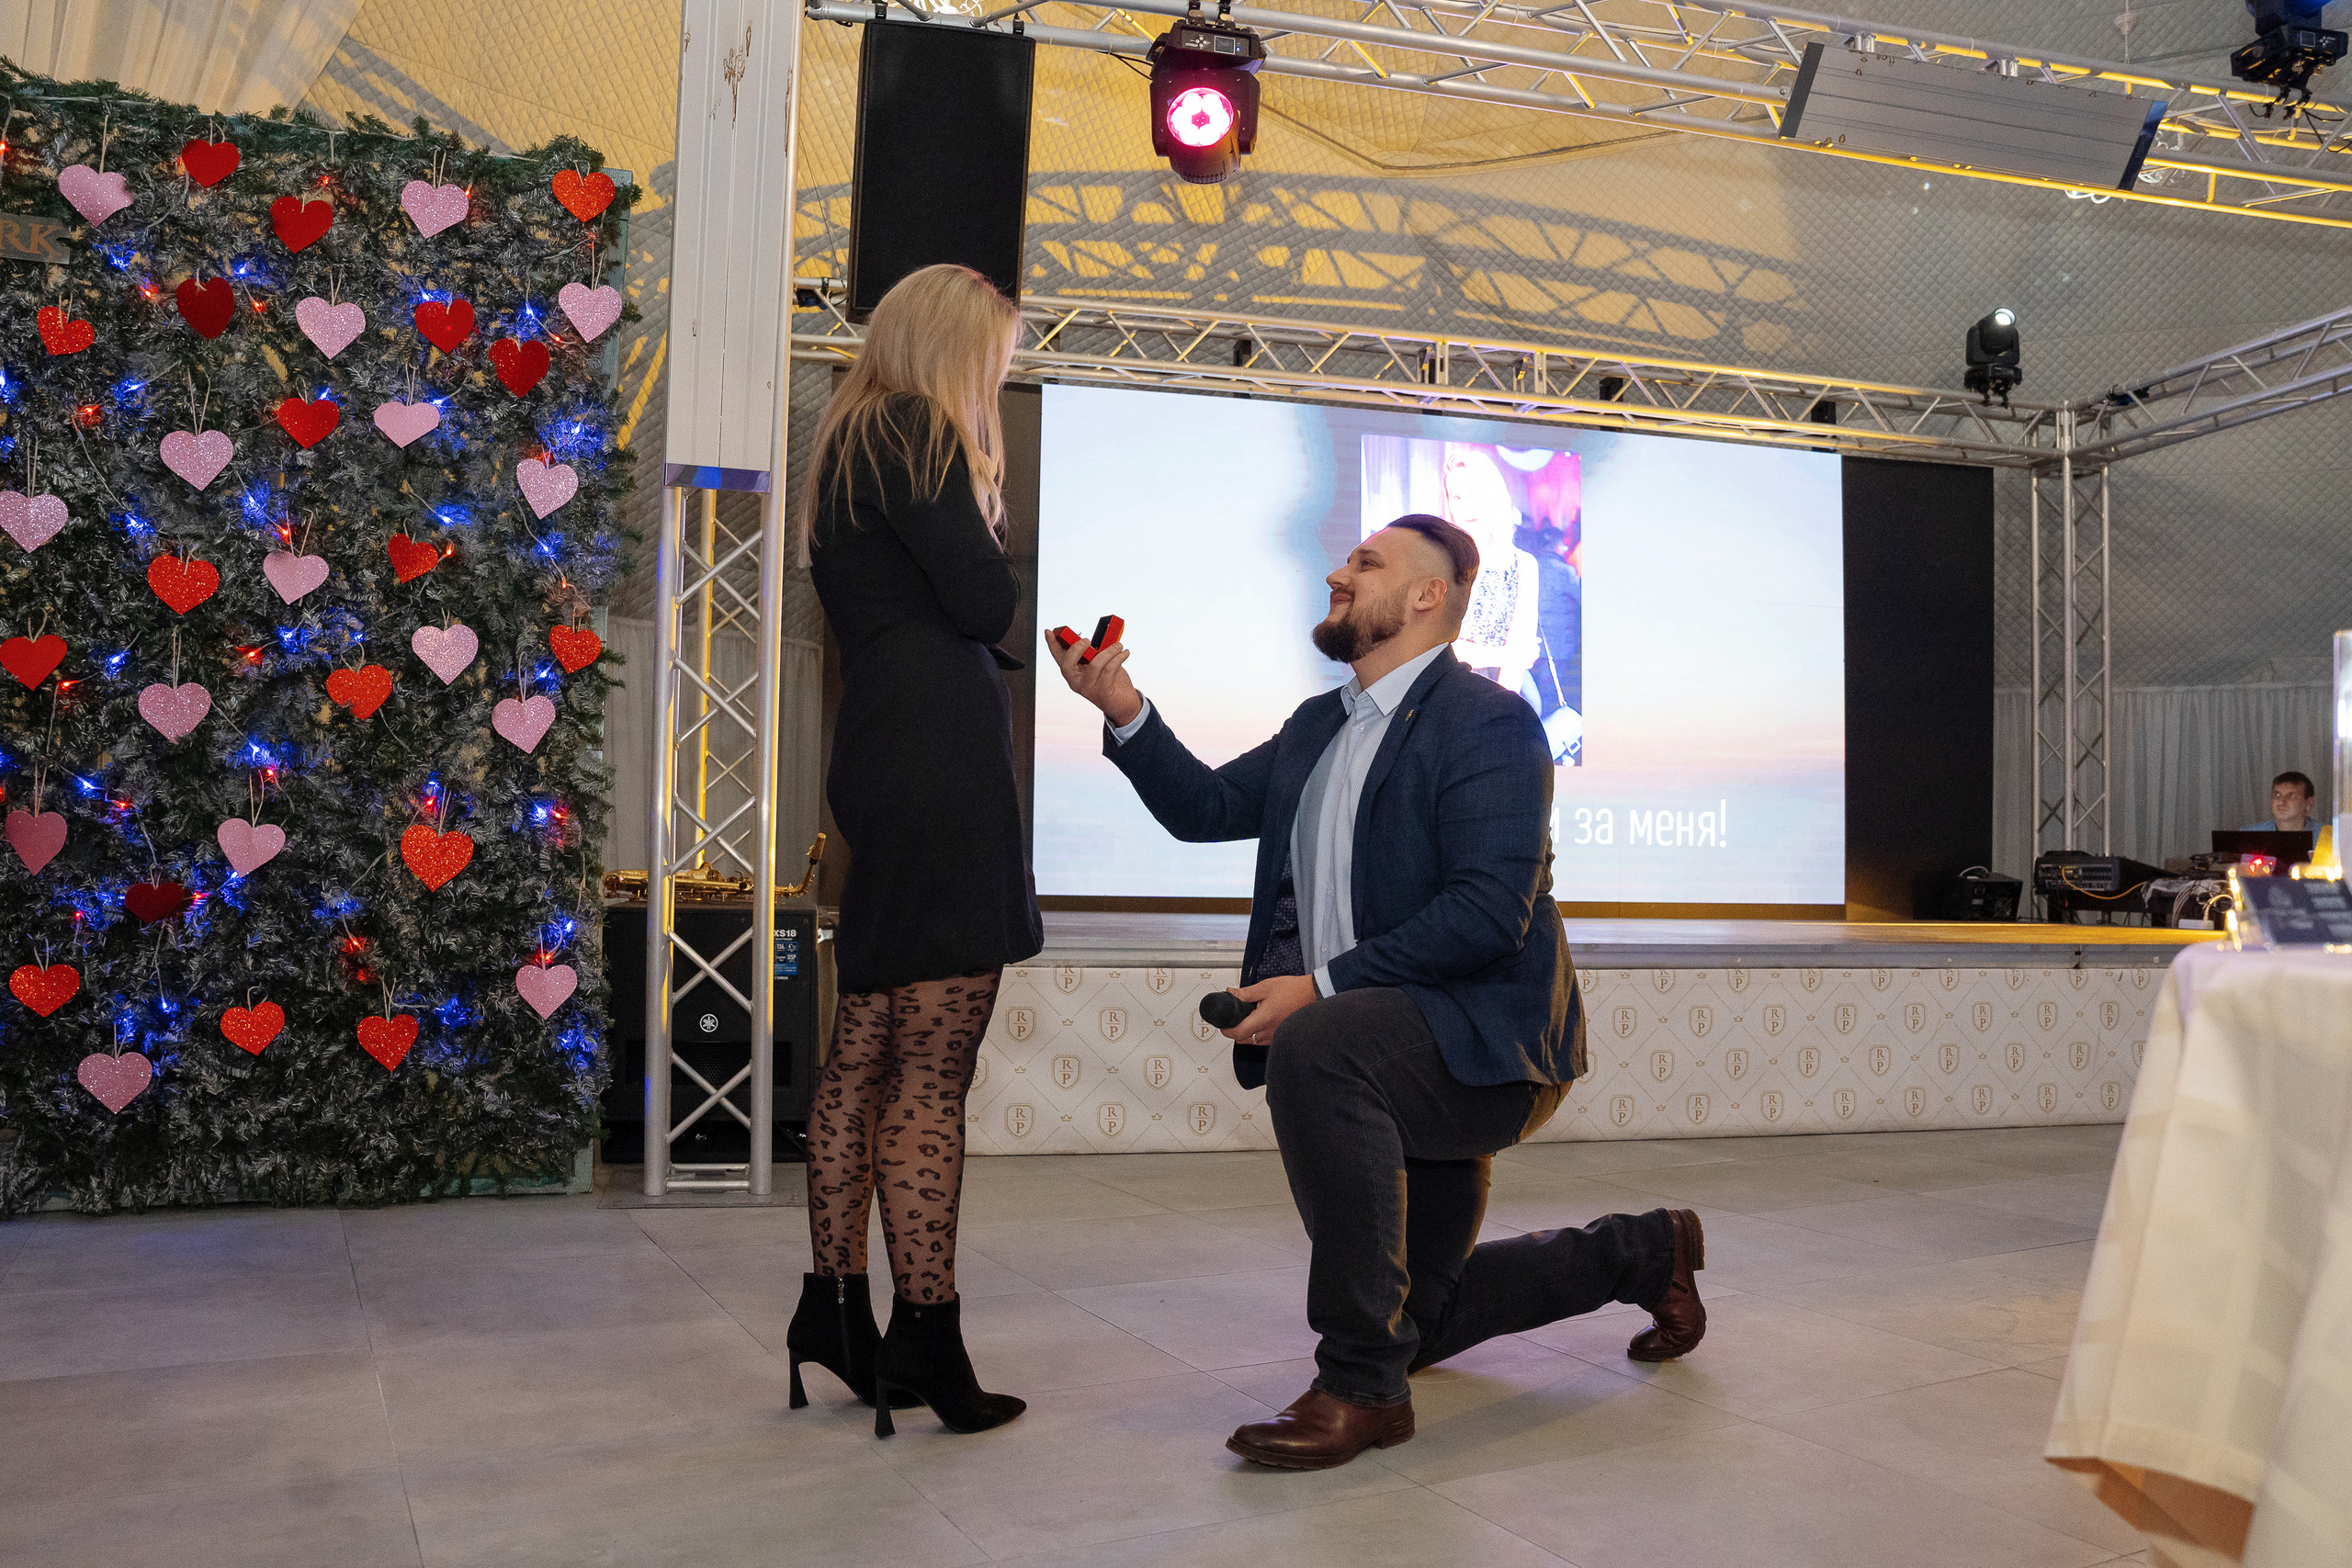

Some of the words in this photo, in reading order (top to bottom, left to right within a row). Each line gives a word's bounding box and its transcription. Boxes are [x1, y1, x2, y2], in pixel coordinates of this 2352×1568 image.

[1575, 807, 1613, 845] за
[1630, 799, 1727, 848] меня!
[1063, 977, 1074, 988] P
[1156, 978, 1166, 990] P
[1016, 1011, 1028, 1021] R
[1109, 1011, 1120, 1021] R
[1016, 1026, 1027, 1037] P
[1109, 1026, 1119, 1037] P
[1200, 1027, 1210, 1038] P
[1062, 1059, 1073, 1069] R
[1154, 1060, 1165, 1069] R
[1061, 1073, 1071, 1084] P
[1153, 1073, 1163, 1085] P
[1015, 1108, 1026, 1118] R
[1107, 1107, 1118, 1117] R
[1197, 1106, 1208, 1116] R
[1015, 1122, 1025, 1134] P
[1107, 1122, 1117, 1133] P
[1197, 1120, 1207, 1131] P
